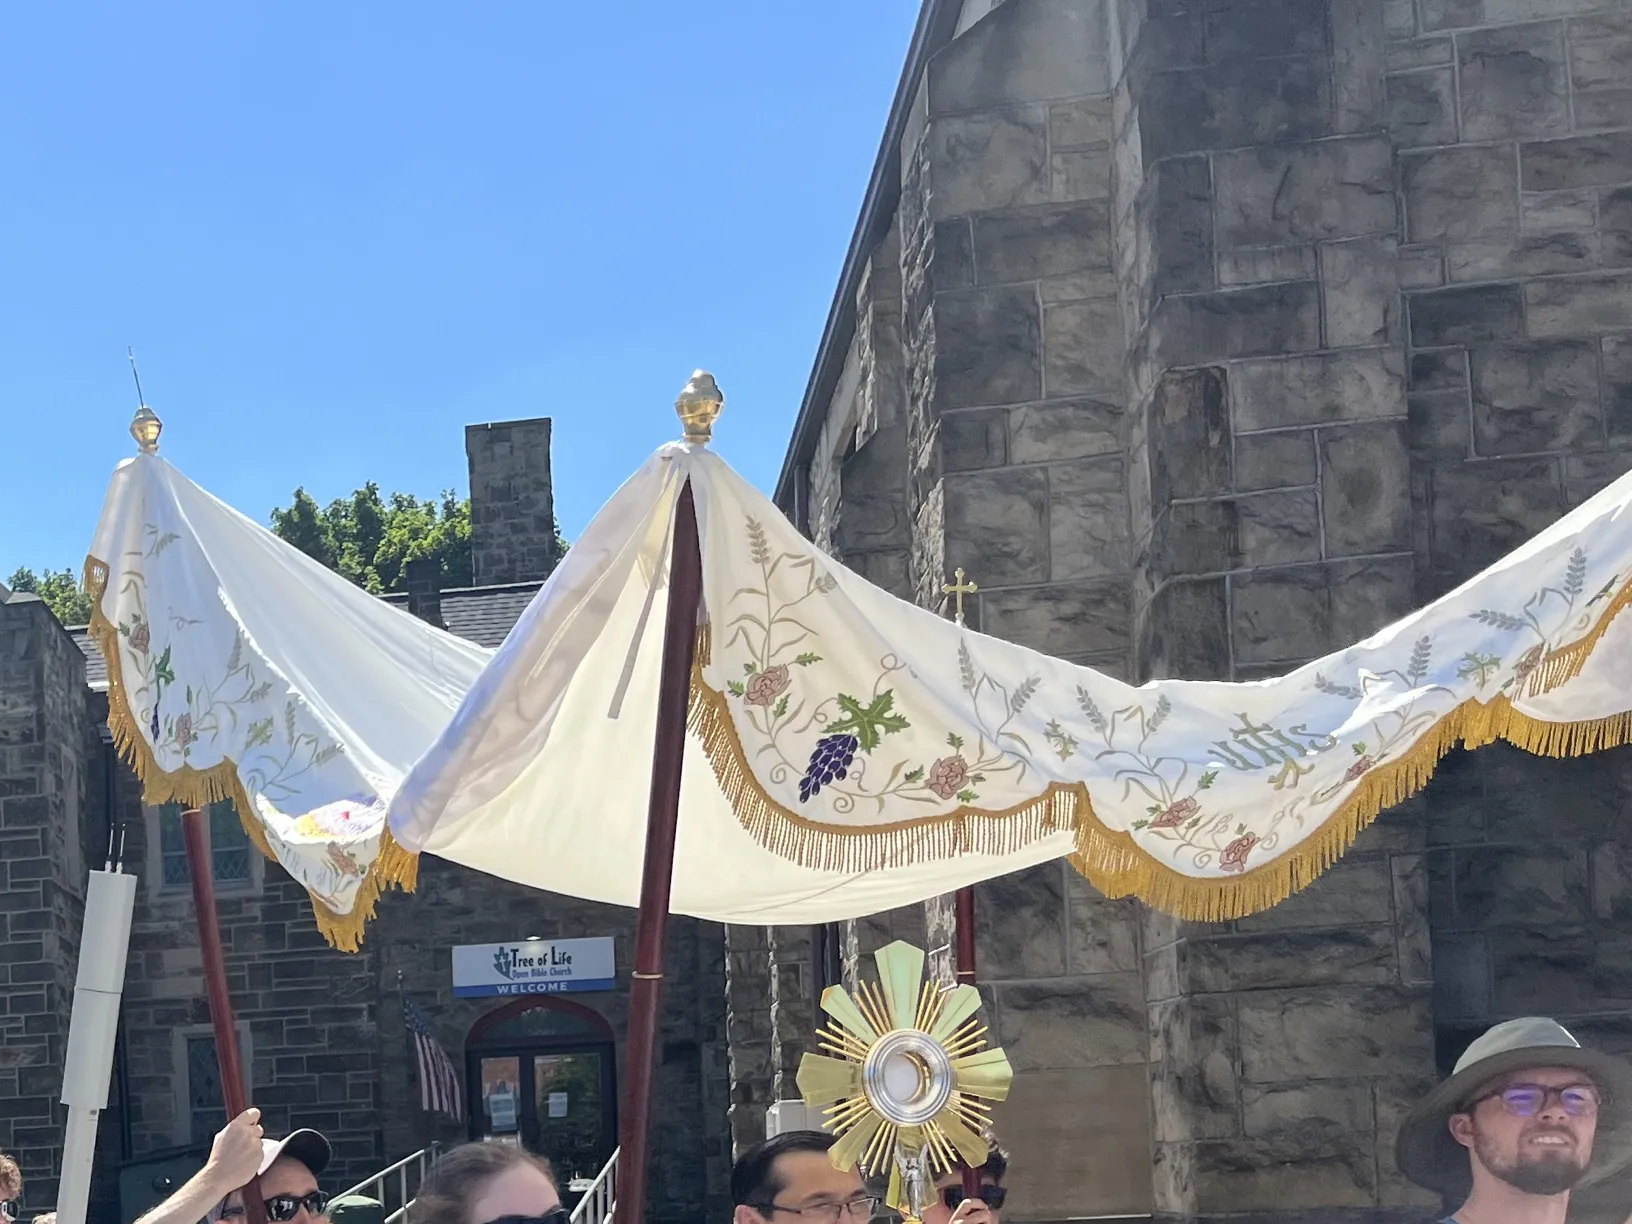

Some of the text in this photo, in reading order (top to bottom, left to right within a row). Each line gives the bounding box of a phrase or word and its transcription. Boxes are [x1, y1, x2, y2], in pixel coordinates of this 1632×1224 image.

[510, 946, 572, 967] Tree of Life
[512, 966, 572, 979] Open Bible Church
[497, 982, 568, 994] WELCOME
